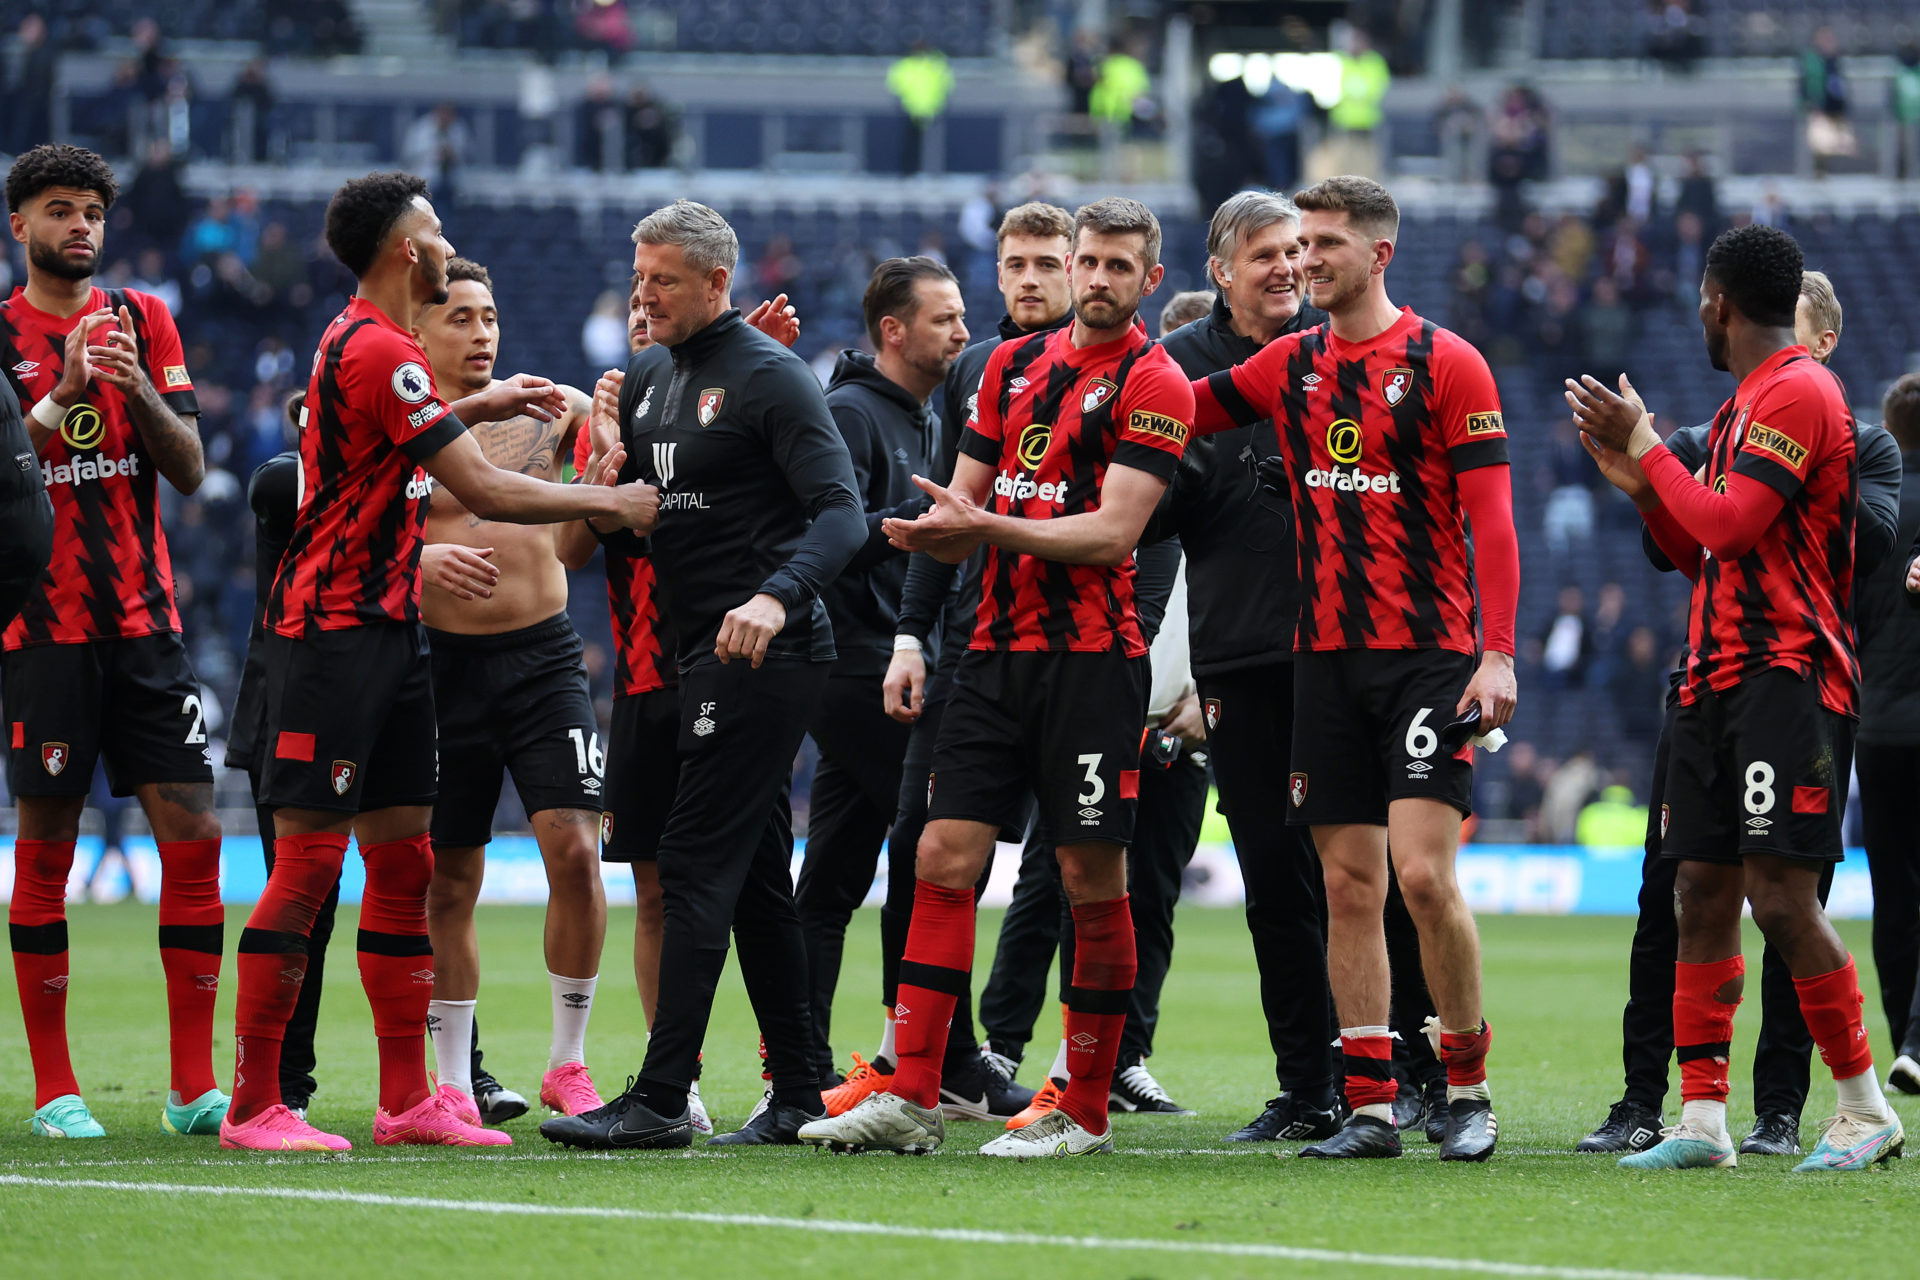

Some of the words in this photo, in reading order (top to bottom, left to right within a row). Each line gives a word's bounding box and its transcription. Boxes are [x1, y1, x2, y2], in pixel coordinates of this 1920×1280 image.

[17, 371, 39, 379] umbro
[420, 401, 438, 416] room
[1304, 463, 1401, 494] dafabet
[700, 701, 717, 716] SF
[181, 694, 206, 744] 2
[1405, 707, 1438, 758] 6
[568, 728, 605, 778] 16
[1077, 753, 1105, 806] 3
[1408, 772, 1429, 780] umbro
[583, 788, 600, 797] umbro
[1743, 760, 1776, 815] 8
[1080, 818, 1100, 826] umbro
[1071, 1045, 1096, 1054] umbro
